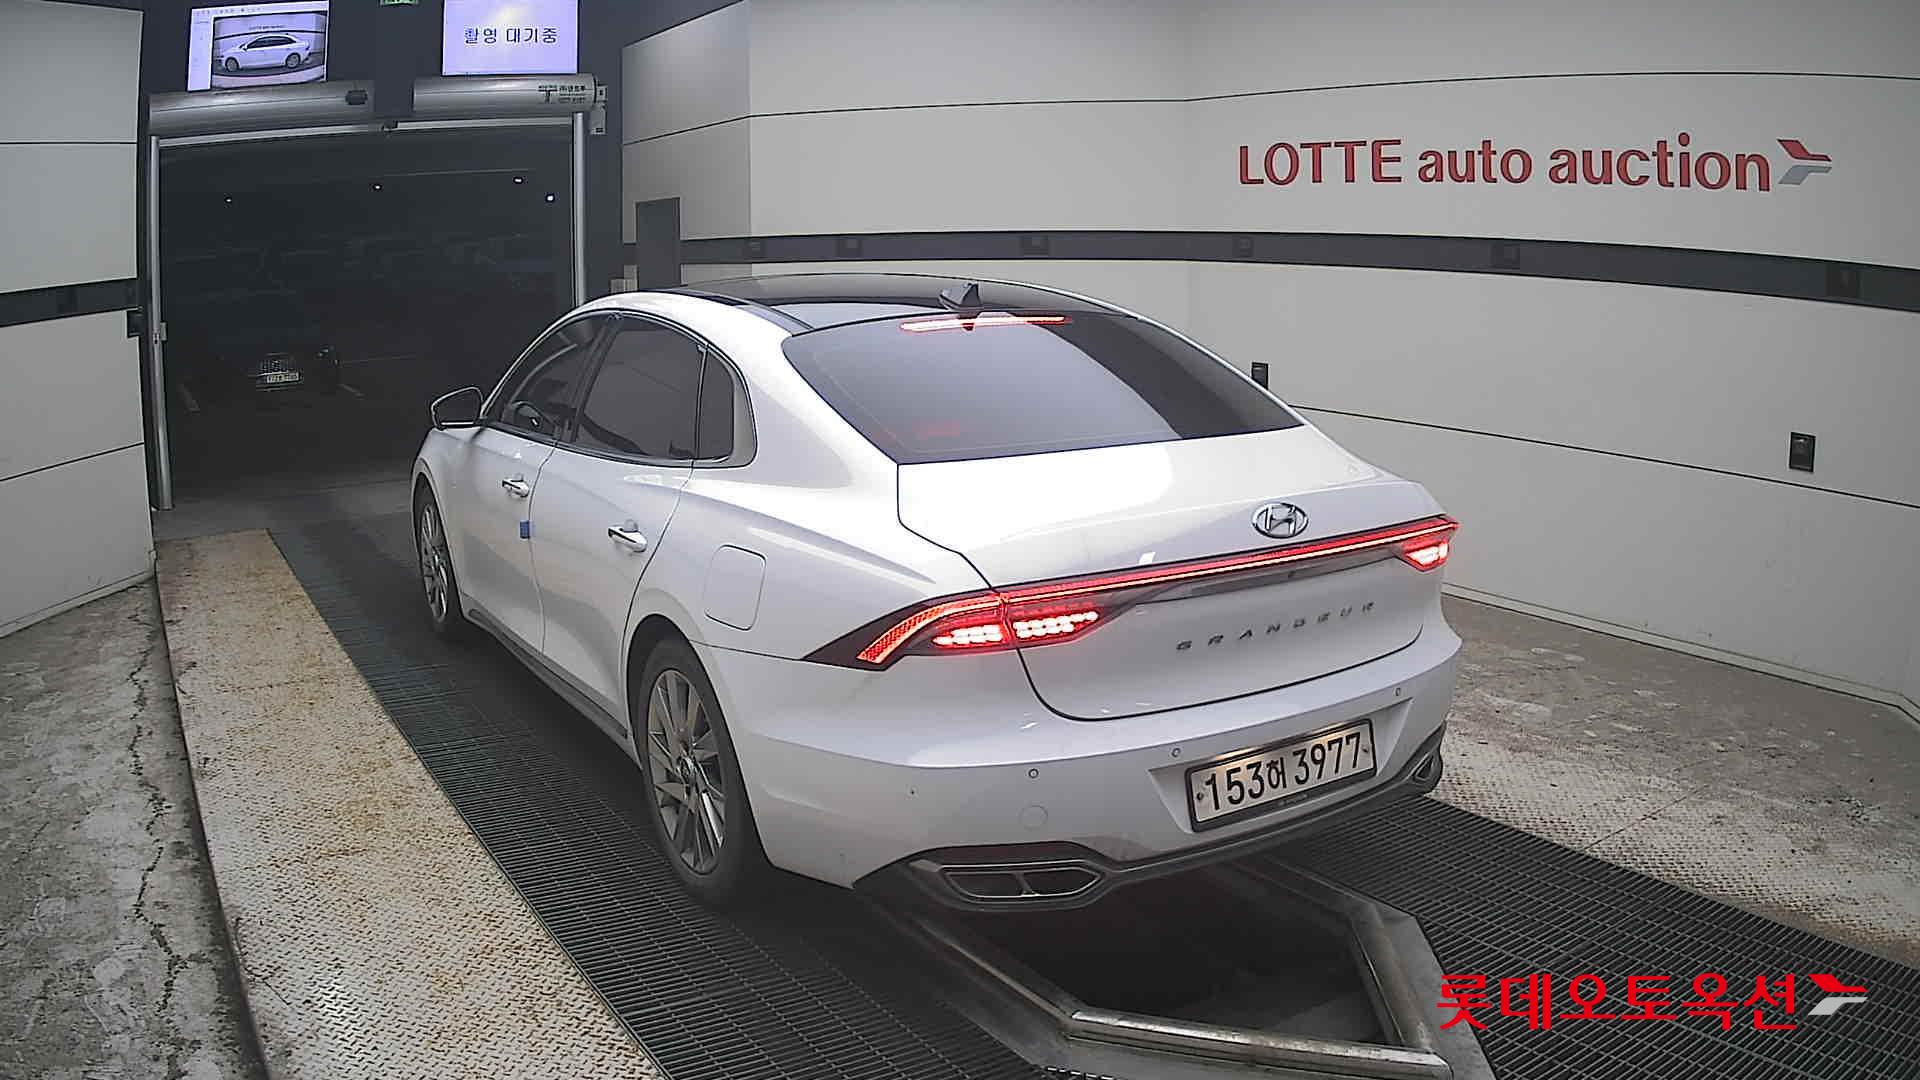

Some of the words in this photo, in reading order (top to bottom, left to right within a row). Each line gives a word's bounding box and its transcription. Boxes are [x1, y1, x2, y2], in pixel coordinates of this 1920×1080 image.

[464, 27, 498, 45] 촬영
[505, 27, 558, 44] 대기중
[1239, 139, 1402, 186] LOTTE
[1417, 139, 1533, 184] auto
[1549, 132, 1771, 192] auction
[1176, 601, 1374, 651] GRANDEUR
[1205, 756, 1288, 811] 153허
[1292, 731, 1361, 785] 3977
